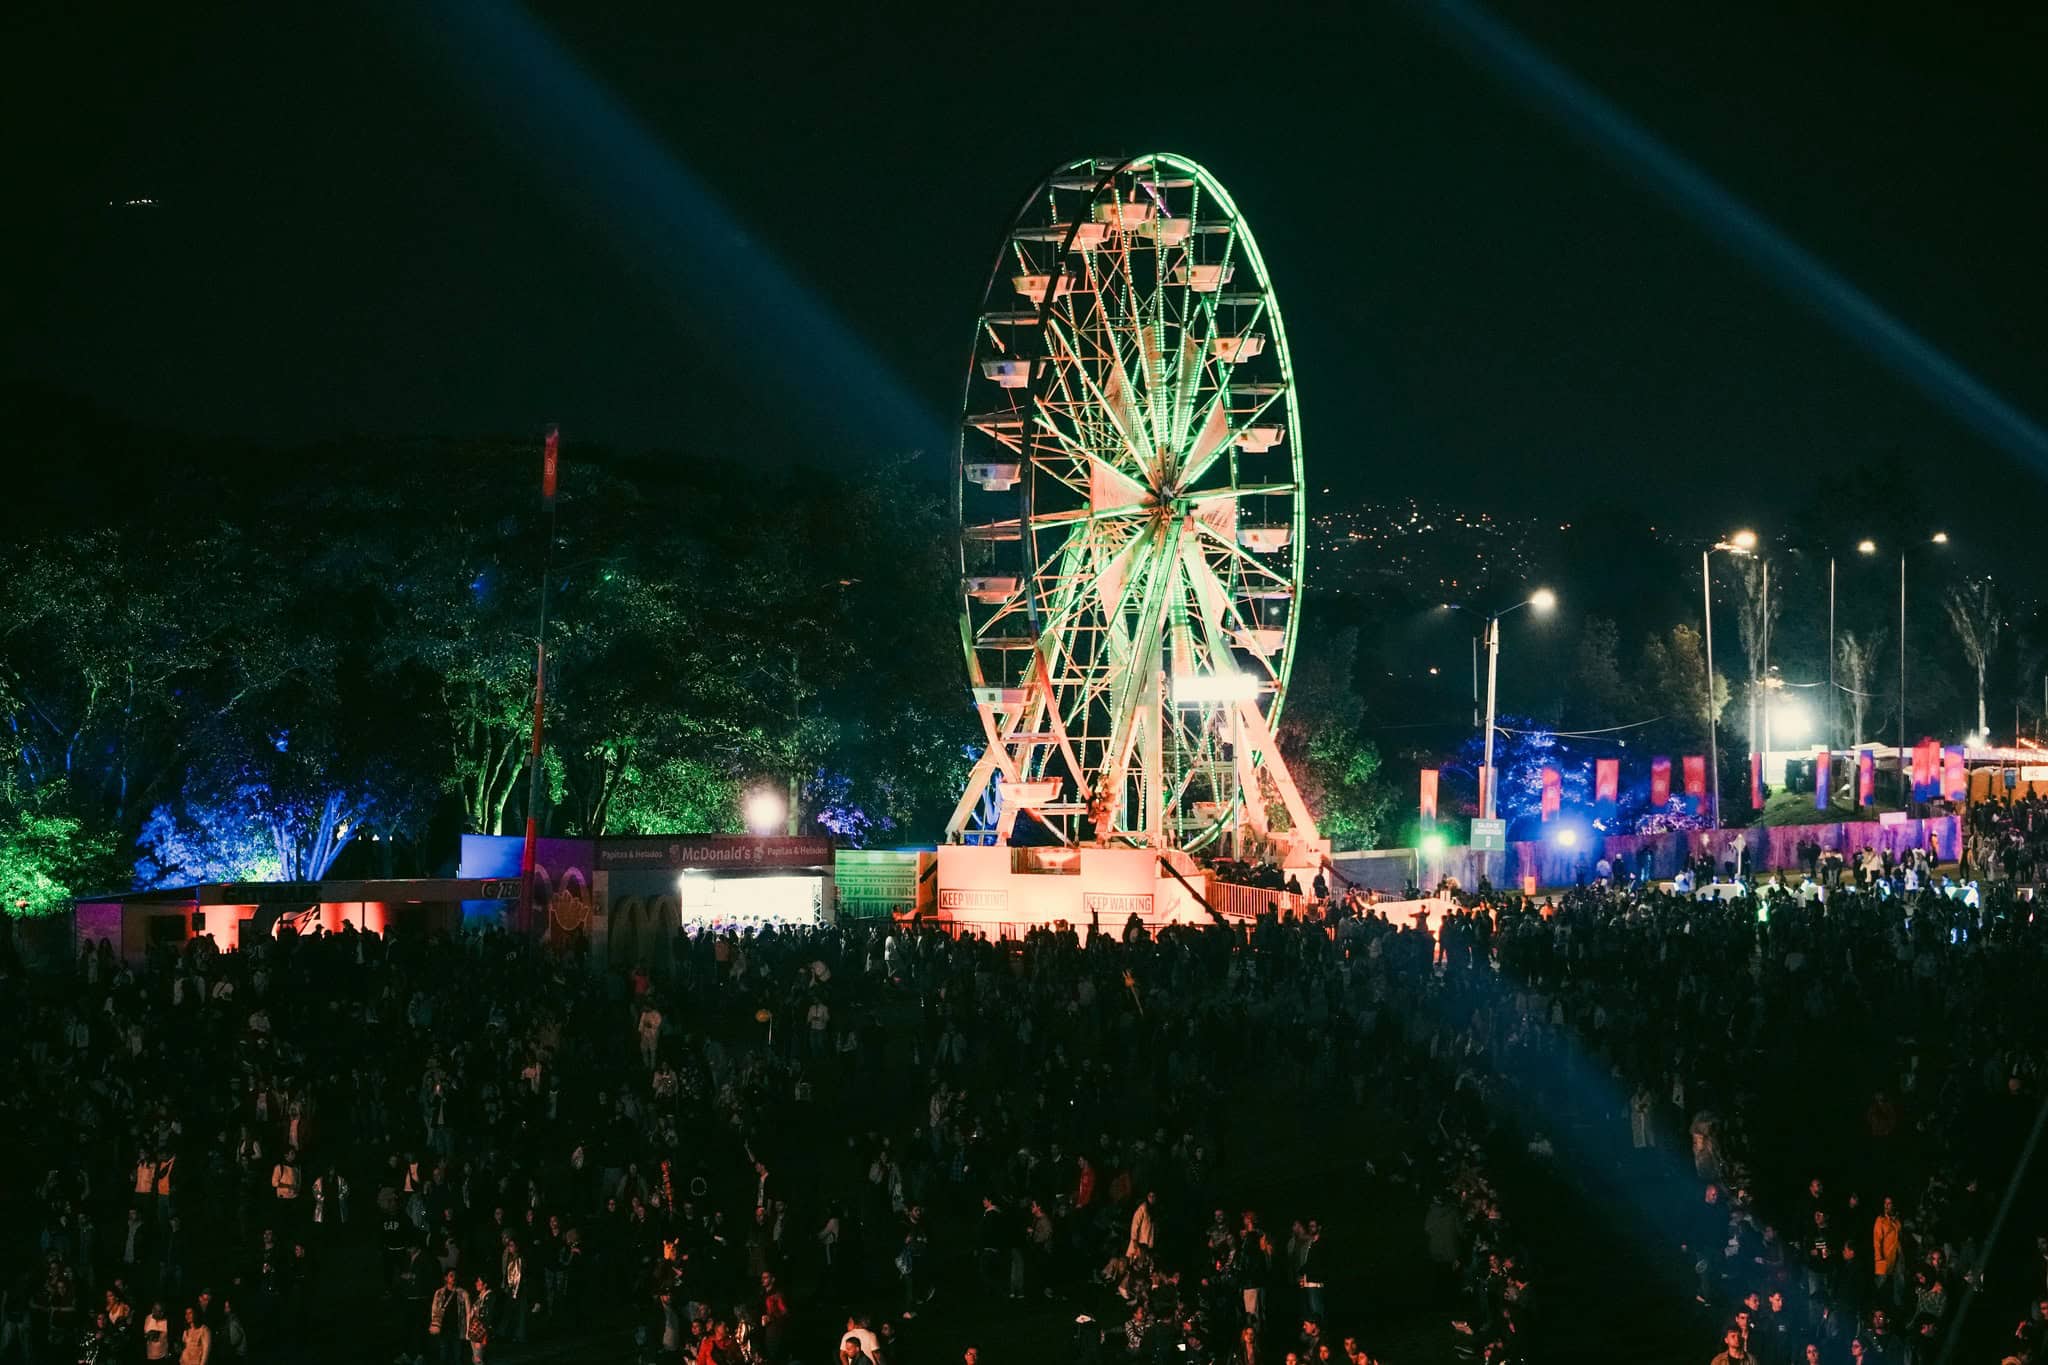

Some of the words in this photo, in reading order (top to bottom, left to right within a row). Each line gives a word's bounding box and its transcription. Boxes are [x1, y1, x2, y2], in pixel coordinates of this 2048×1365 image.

[682, 846, 751, 861] McDonald's
[767, 847, 793, 857] Papitas
[794, 846, 799, 855] &
[800, 846, 828, 856] Helados
[942, 892, 964, 906] KEEP
[965, 893, 1005, 906] WALKING
[1086, 896, 1108, 910] KEEP
[1110, 896, 1151, 911] WALKING
